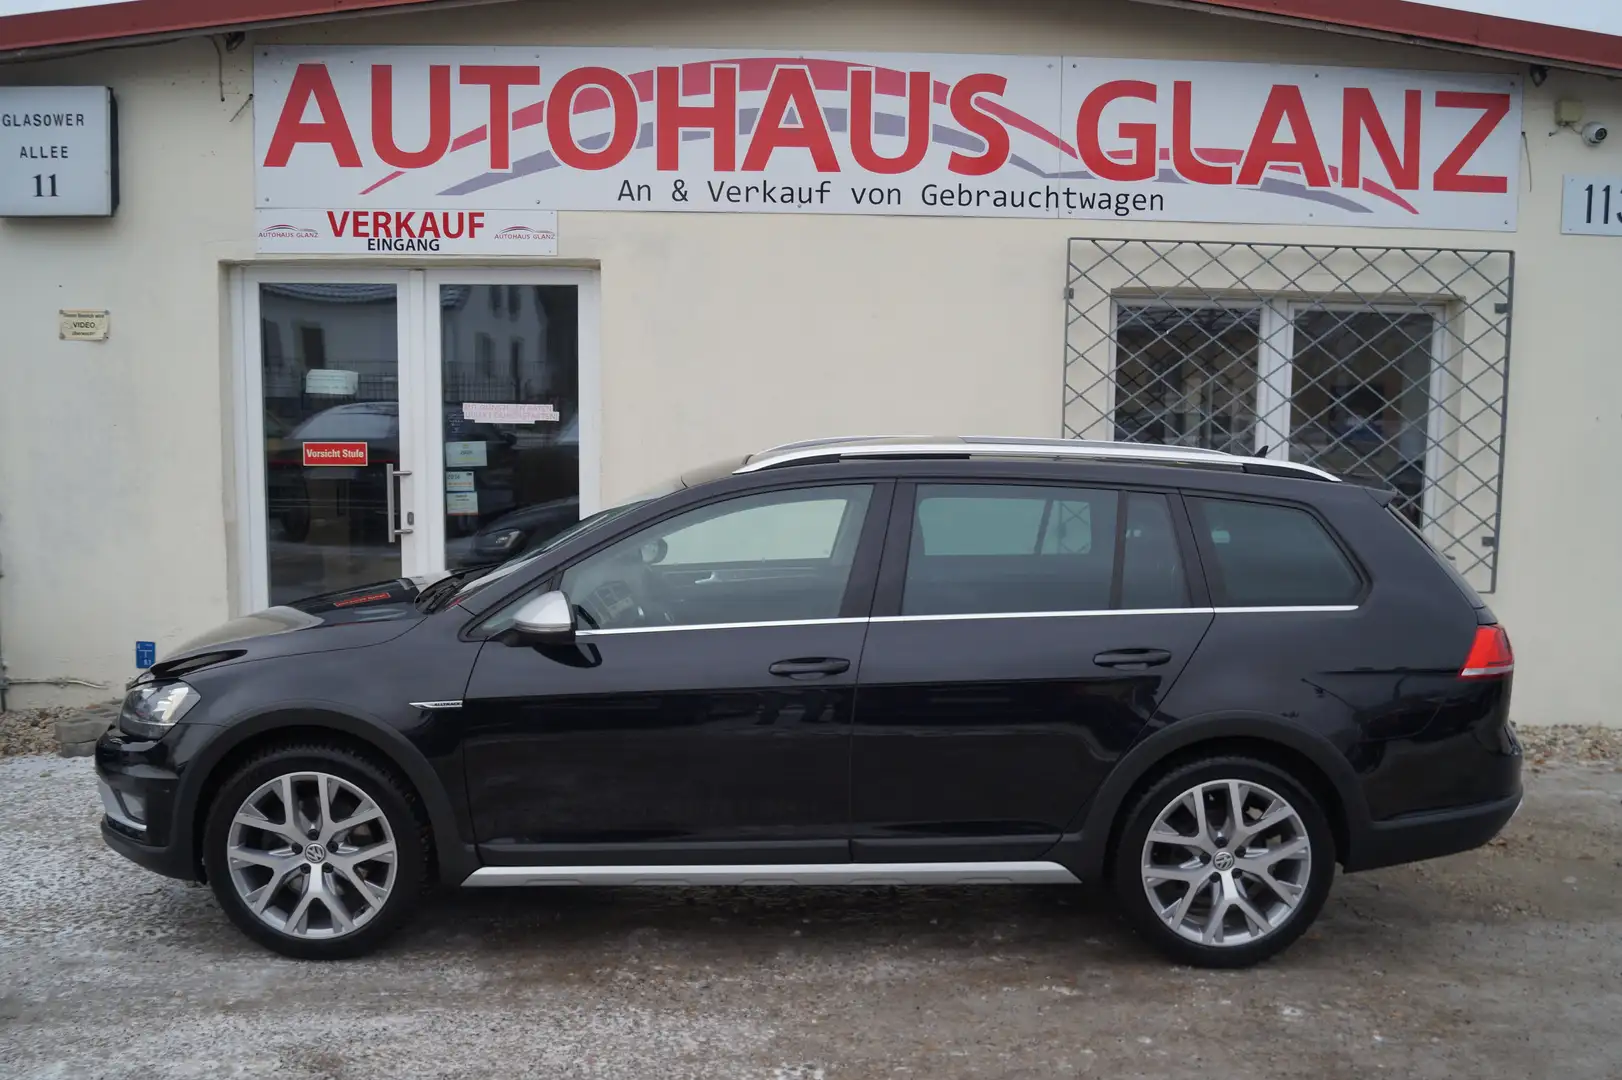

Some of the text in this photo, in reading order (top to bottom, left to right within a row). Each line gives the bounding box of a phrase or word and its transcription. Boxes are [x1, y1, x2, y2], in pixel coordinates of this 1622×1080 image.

[1, 113, 85, 127] GLASOWER
[263, 63, 1511, 193] AUTOHAUS GLANZ
[19, 145, 69, 159] ALLEE
[32, 173, 59, 198] 11
[617, 179, 1164, 217] An & Verkauf von Gebrauchtwagen
[326, 210, 485, 239] VERKAUF
[367, 238, 440, 252] EINGANG
[72, 321, 96, 329] VIDEO
[306, 448, 364, 458] Vorsicht Stufe
